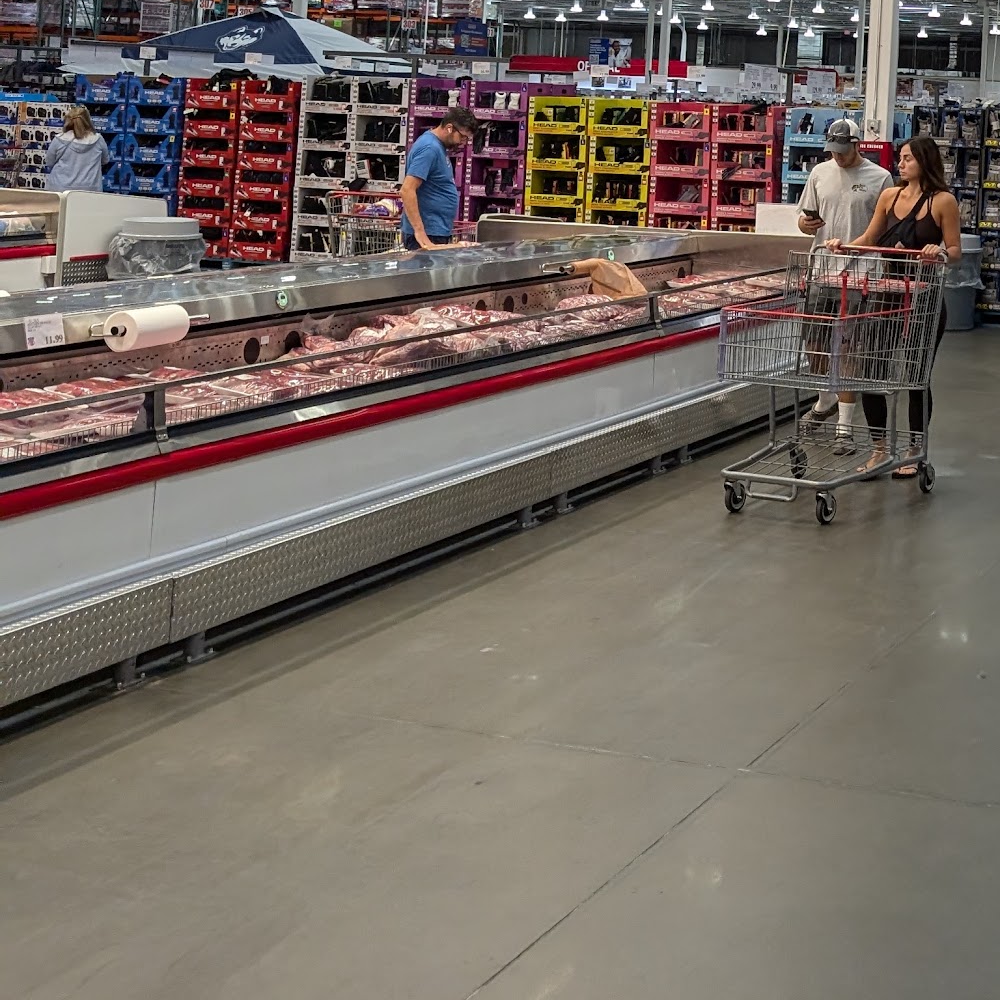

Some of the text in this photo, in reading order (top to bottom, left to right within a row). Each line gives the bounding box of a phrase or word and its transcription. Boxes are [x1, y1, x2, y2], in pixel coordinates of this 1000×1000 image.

[200, 0, 214, 8] 307
[403, 20, 416, 29] 303
[45, 334, 64, 345] 11.99
